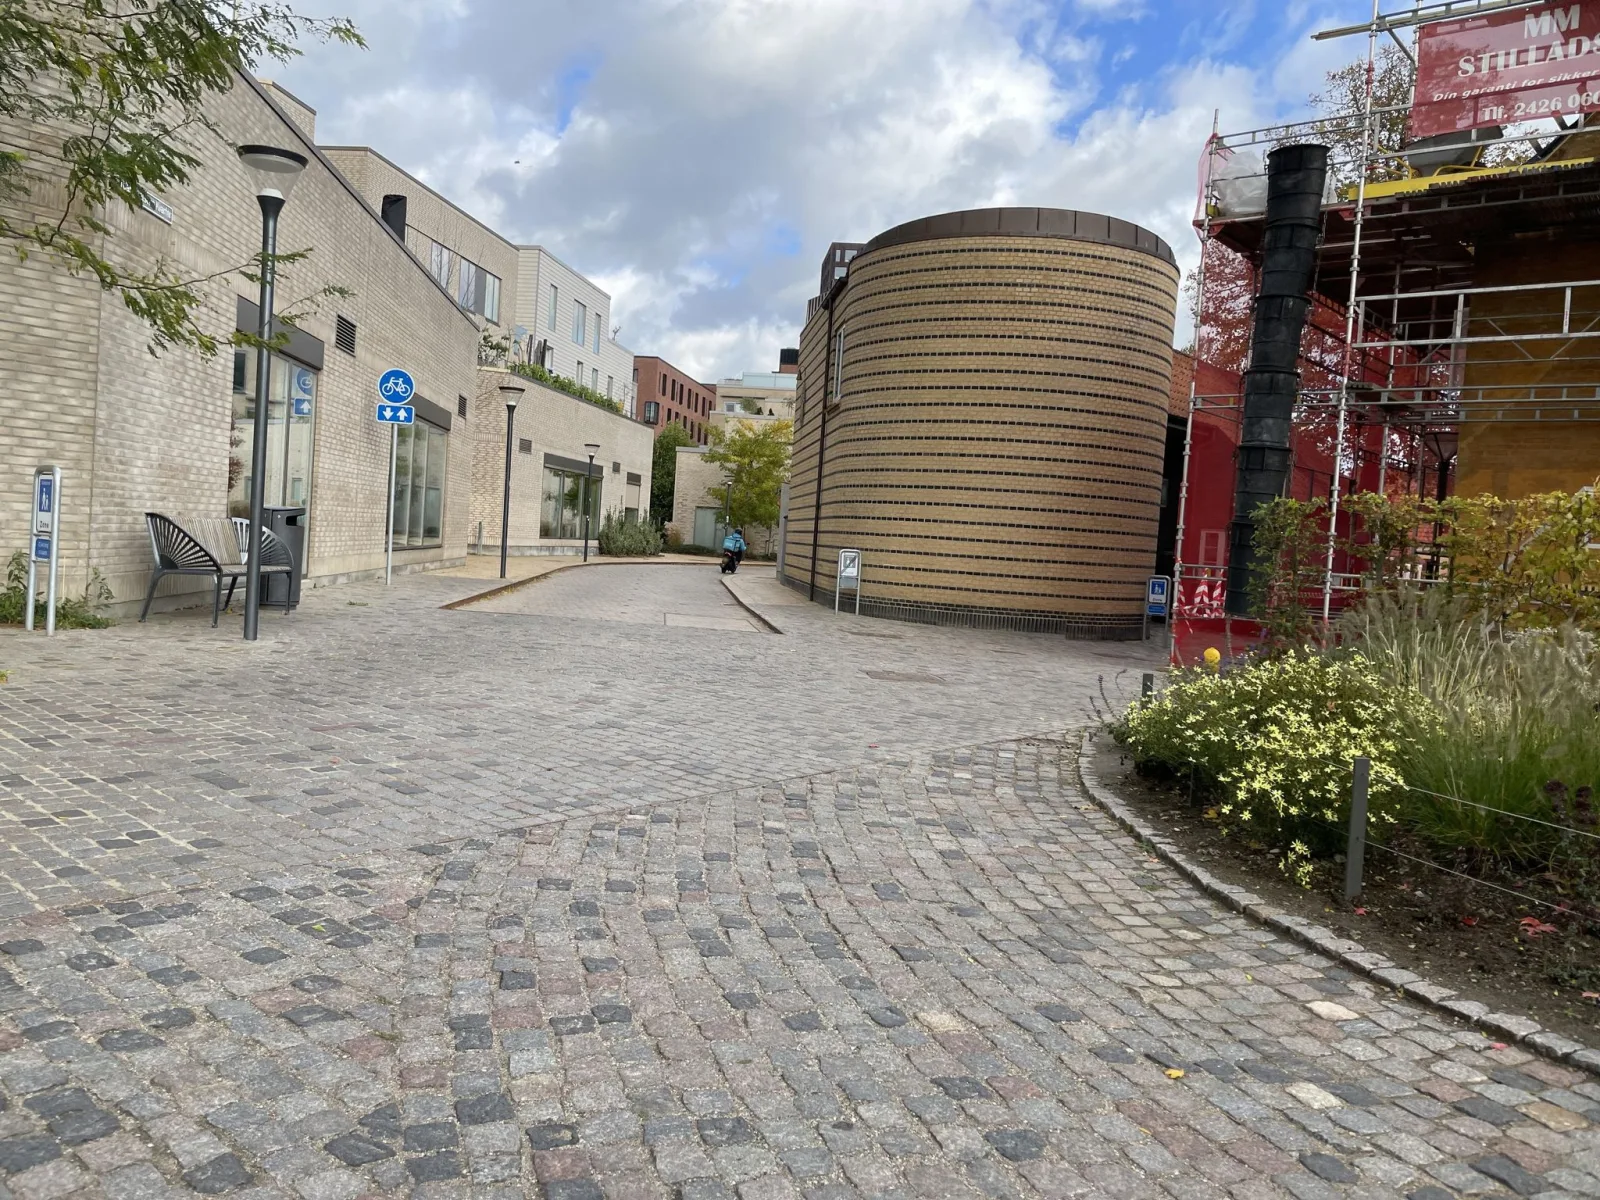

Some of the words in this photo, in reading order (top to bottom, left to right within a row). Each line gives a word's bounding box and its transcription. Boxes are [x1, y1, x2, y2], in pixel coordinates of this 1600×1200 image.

[1524, 4, 1580, 39] MM
[1433, 92, 1457, 102] Din
[1462, 81, 1517, 100] garanti
[1521, 77, 1544, 88] for
[1482, 105, 1508, 120] Tlf.
[1514, 97, 1562, 116] 2426
